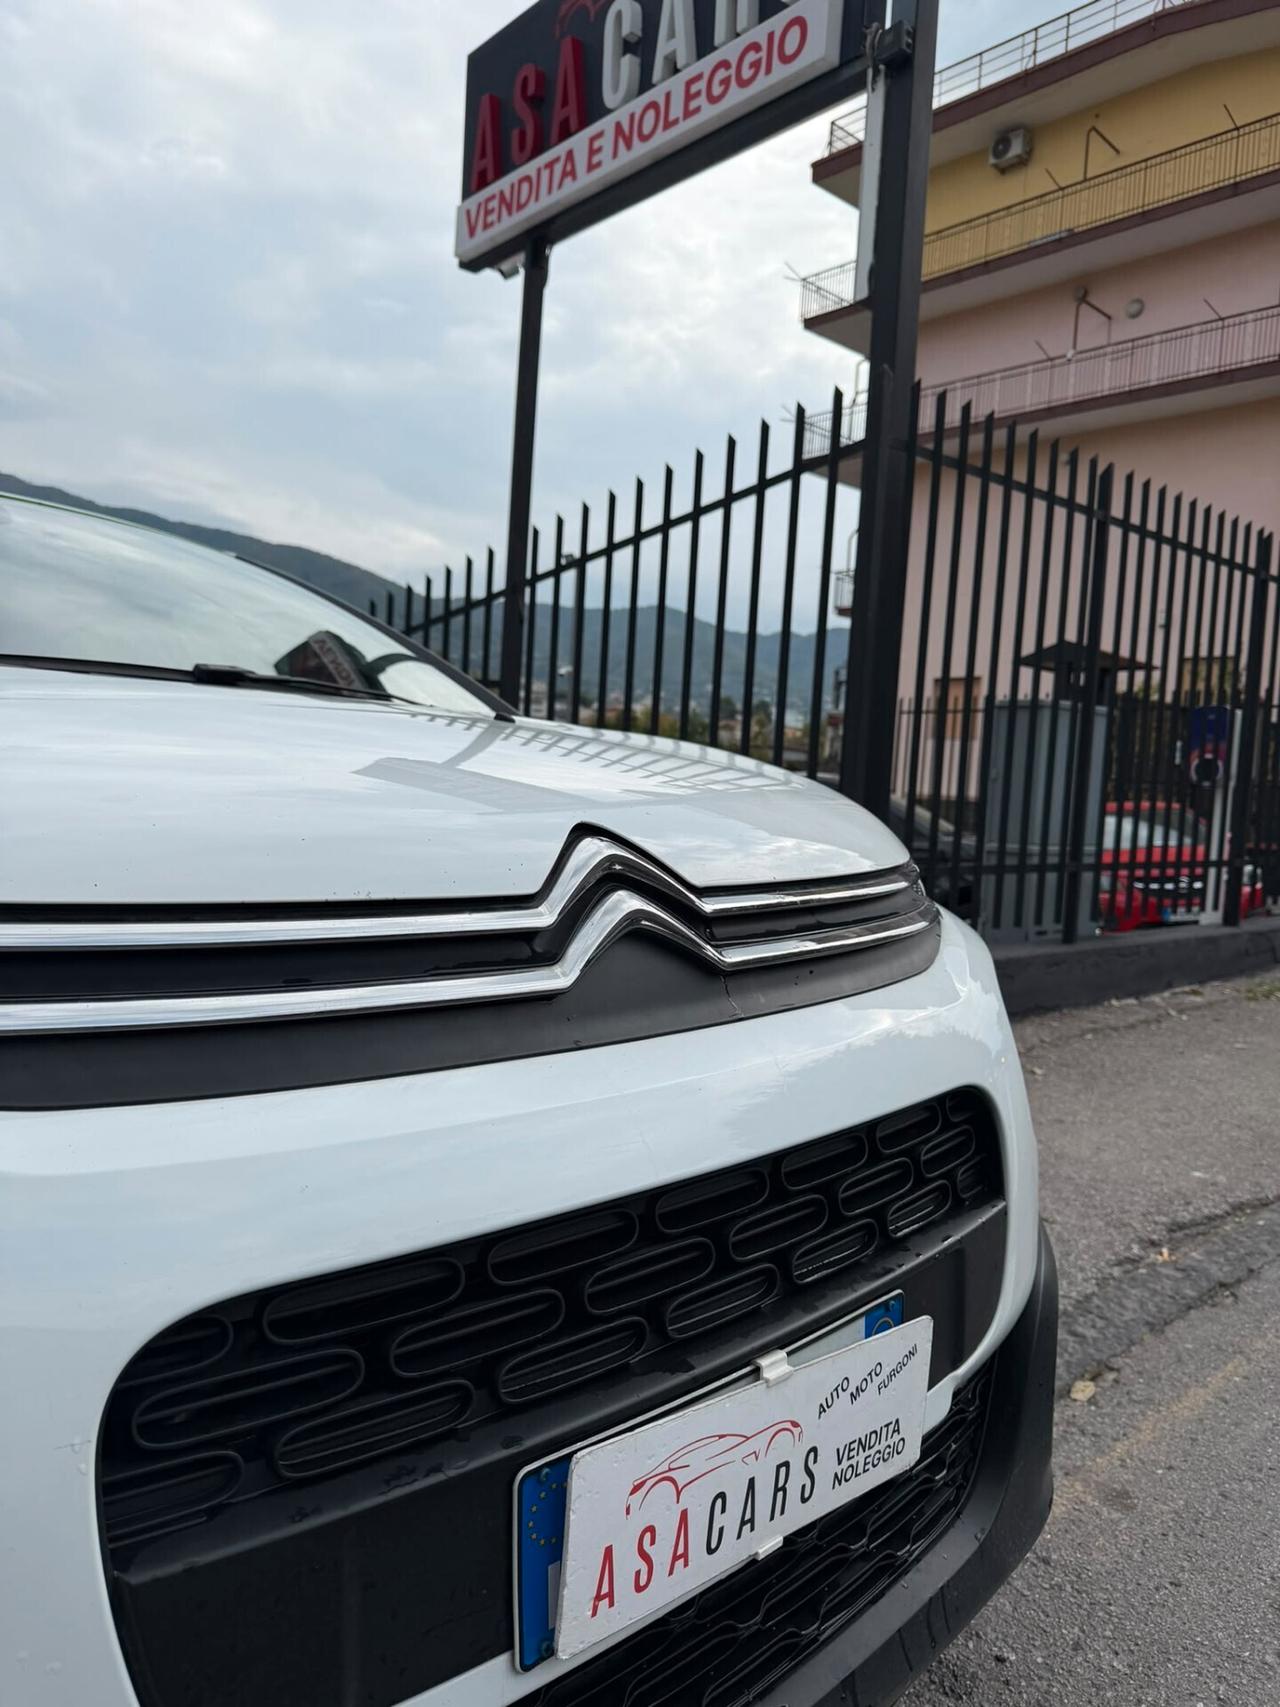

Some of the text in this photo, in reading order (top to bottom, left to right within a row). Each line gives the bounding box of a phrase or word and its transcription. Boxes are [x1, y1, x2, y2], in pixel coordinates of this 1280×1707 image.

[465, 15, 808, 239] VENDITA E NOLEGGIO
[849, 1361, 883, 1405] MOTO
[877, 1343, 918, 1396] FURGONI
[818, 1376, 850, 1420] AUTO
[832, 1437, 906, 1490] NOLEGGIO
[836, 1417, 901, 1466] VENDITA
